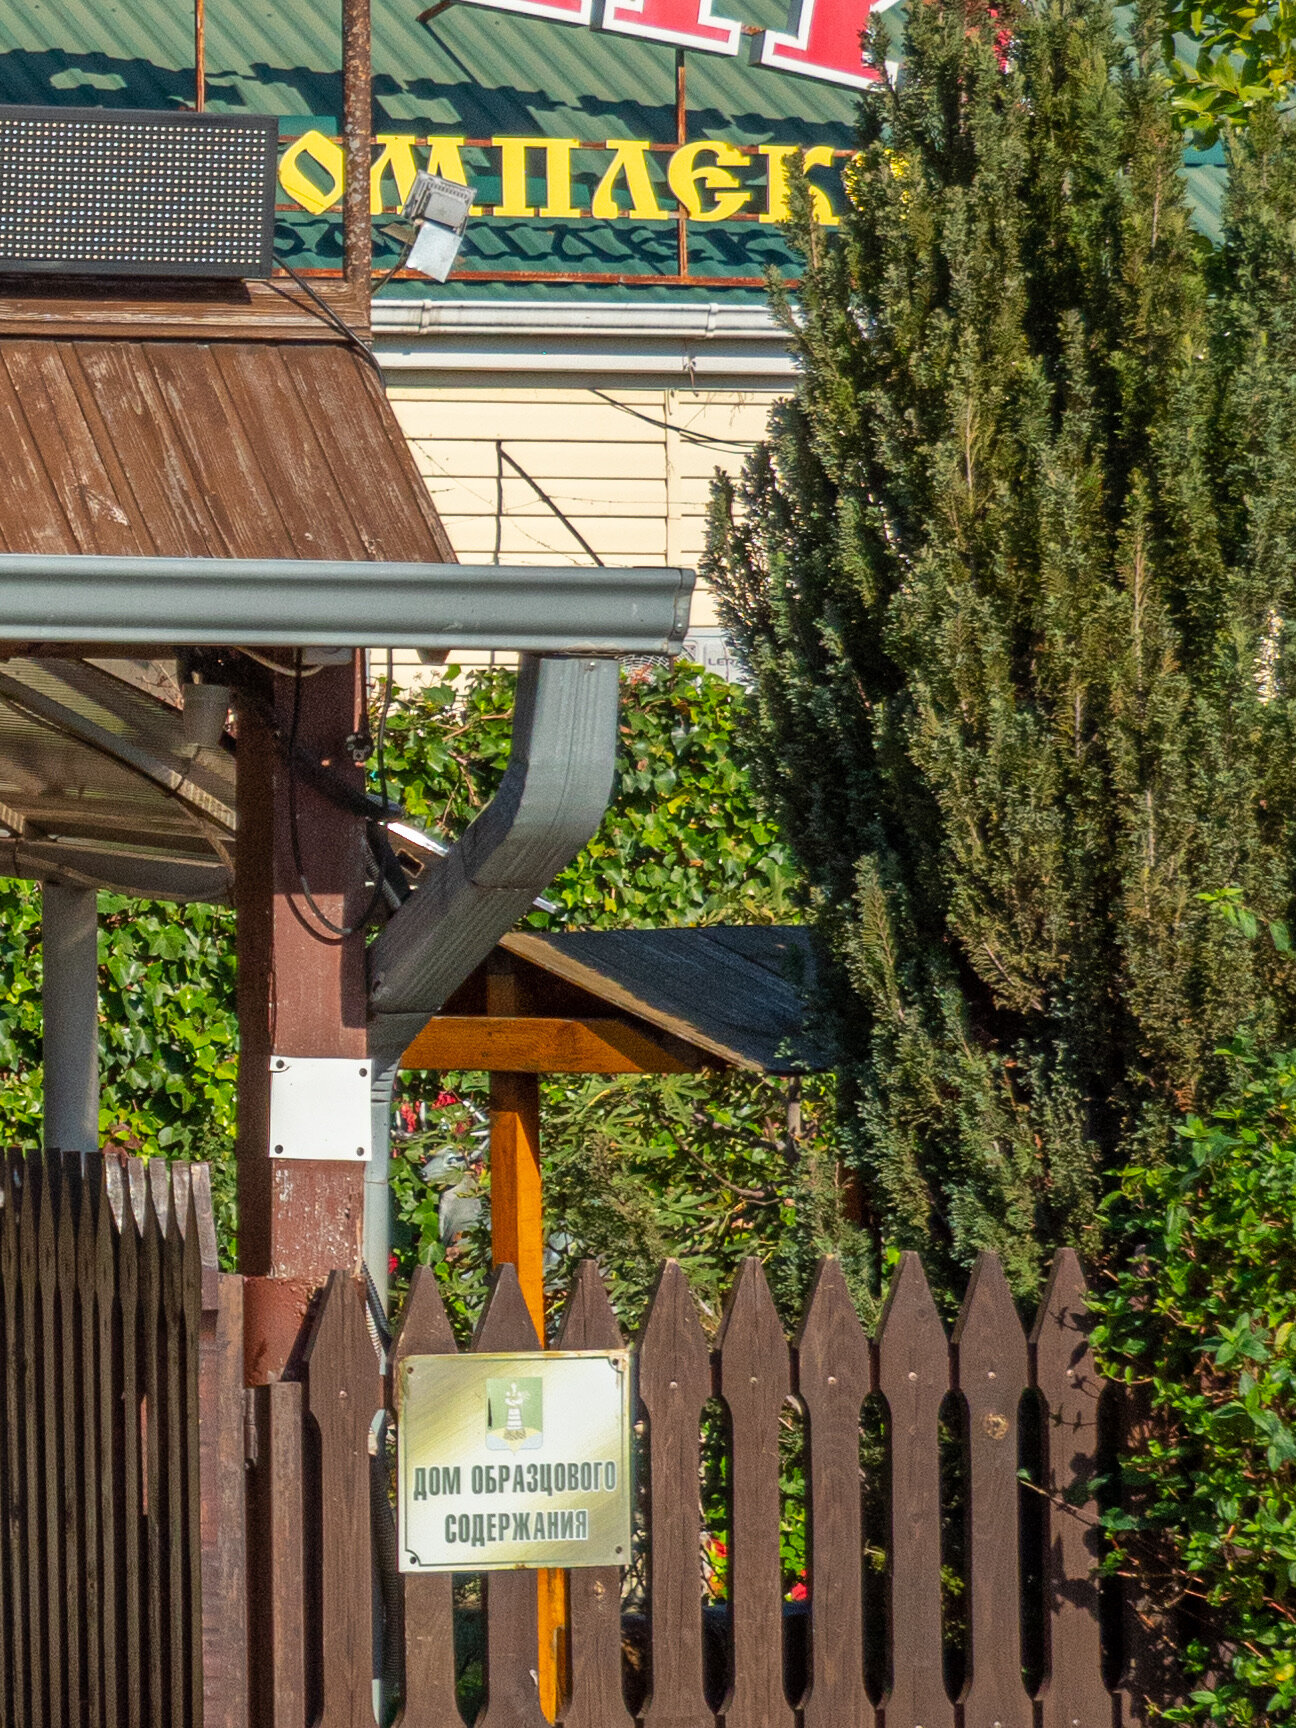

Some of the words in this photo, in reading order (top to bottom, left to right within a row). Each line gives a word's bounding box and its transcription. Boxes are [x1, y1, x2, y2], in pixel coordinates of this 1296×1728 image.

[276, 129, 910, 226] ОМПЛЕК
[413, 1466, 462, 1501] ДОМ
[471, 1461, 617, 1496] ОБРАЗЦОВОГО
[444, 1510, 589, 1547] СОДЕРЖАНИЯ
